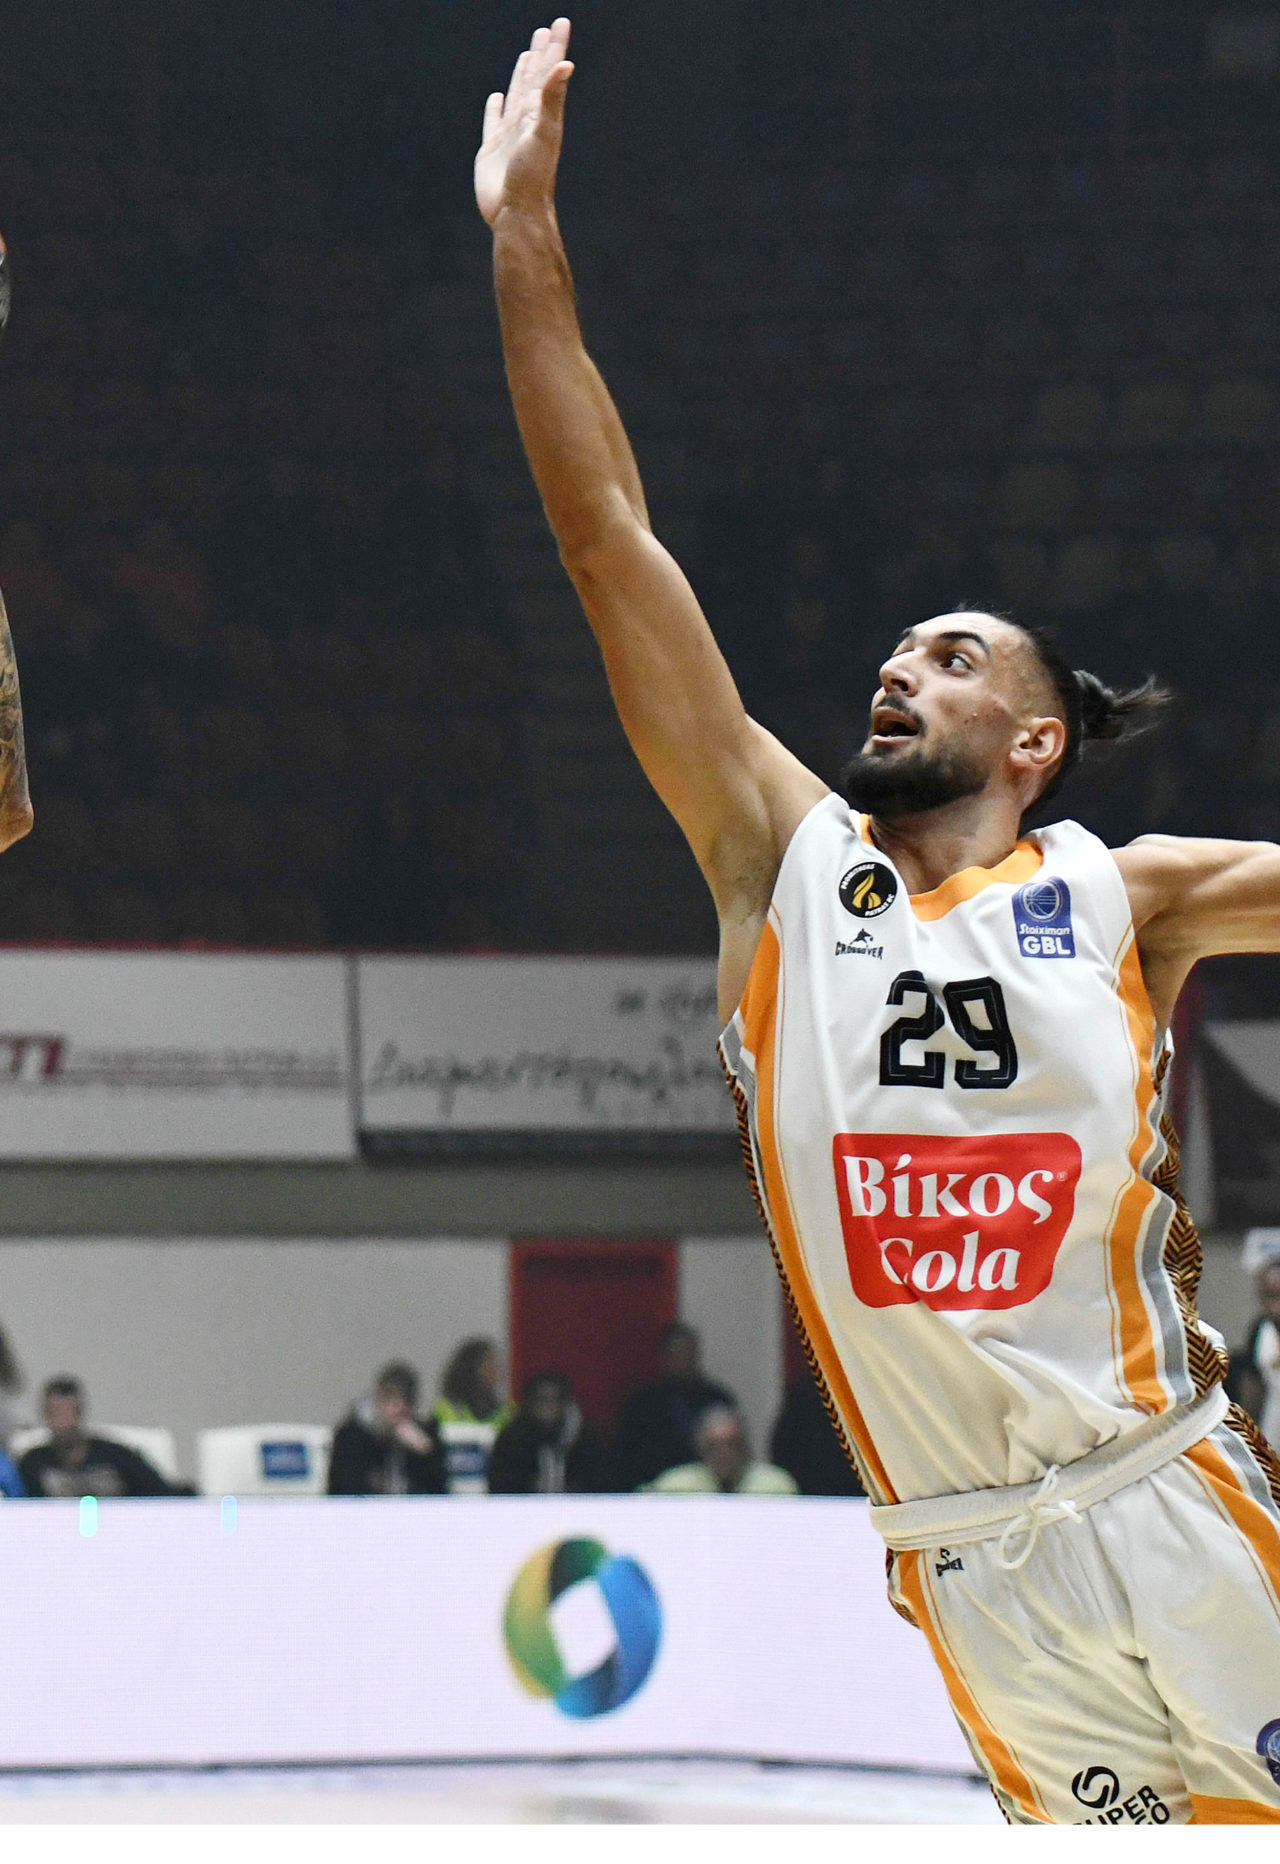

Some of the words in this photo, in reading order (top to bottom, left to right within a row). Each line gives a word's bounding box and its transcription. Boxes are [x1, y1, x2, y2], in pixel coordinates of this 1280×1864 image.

[1019, 923, 1070, 936] Stoiximan
[1022, 936, 1071, 955] GBL
[879, 970, 1018, 1089] 29
[880, 1230, 1020, 1292] Cola
